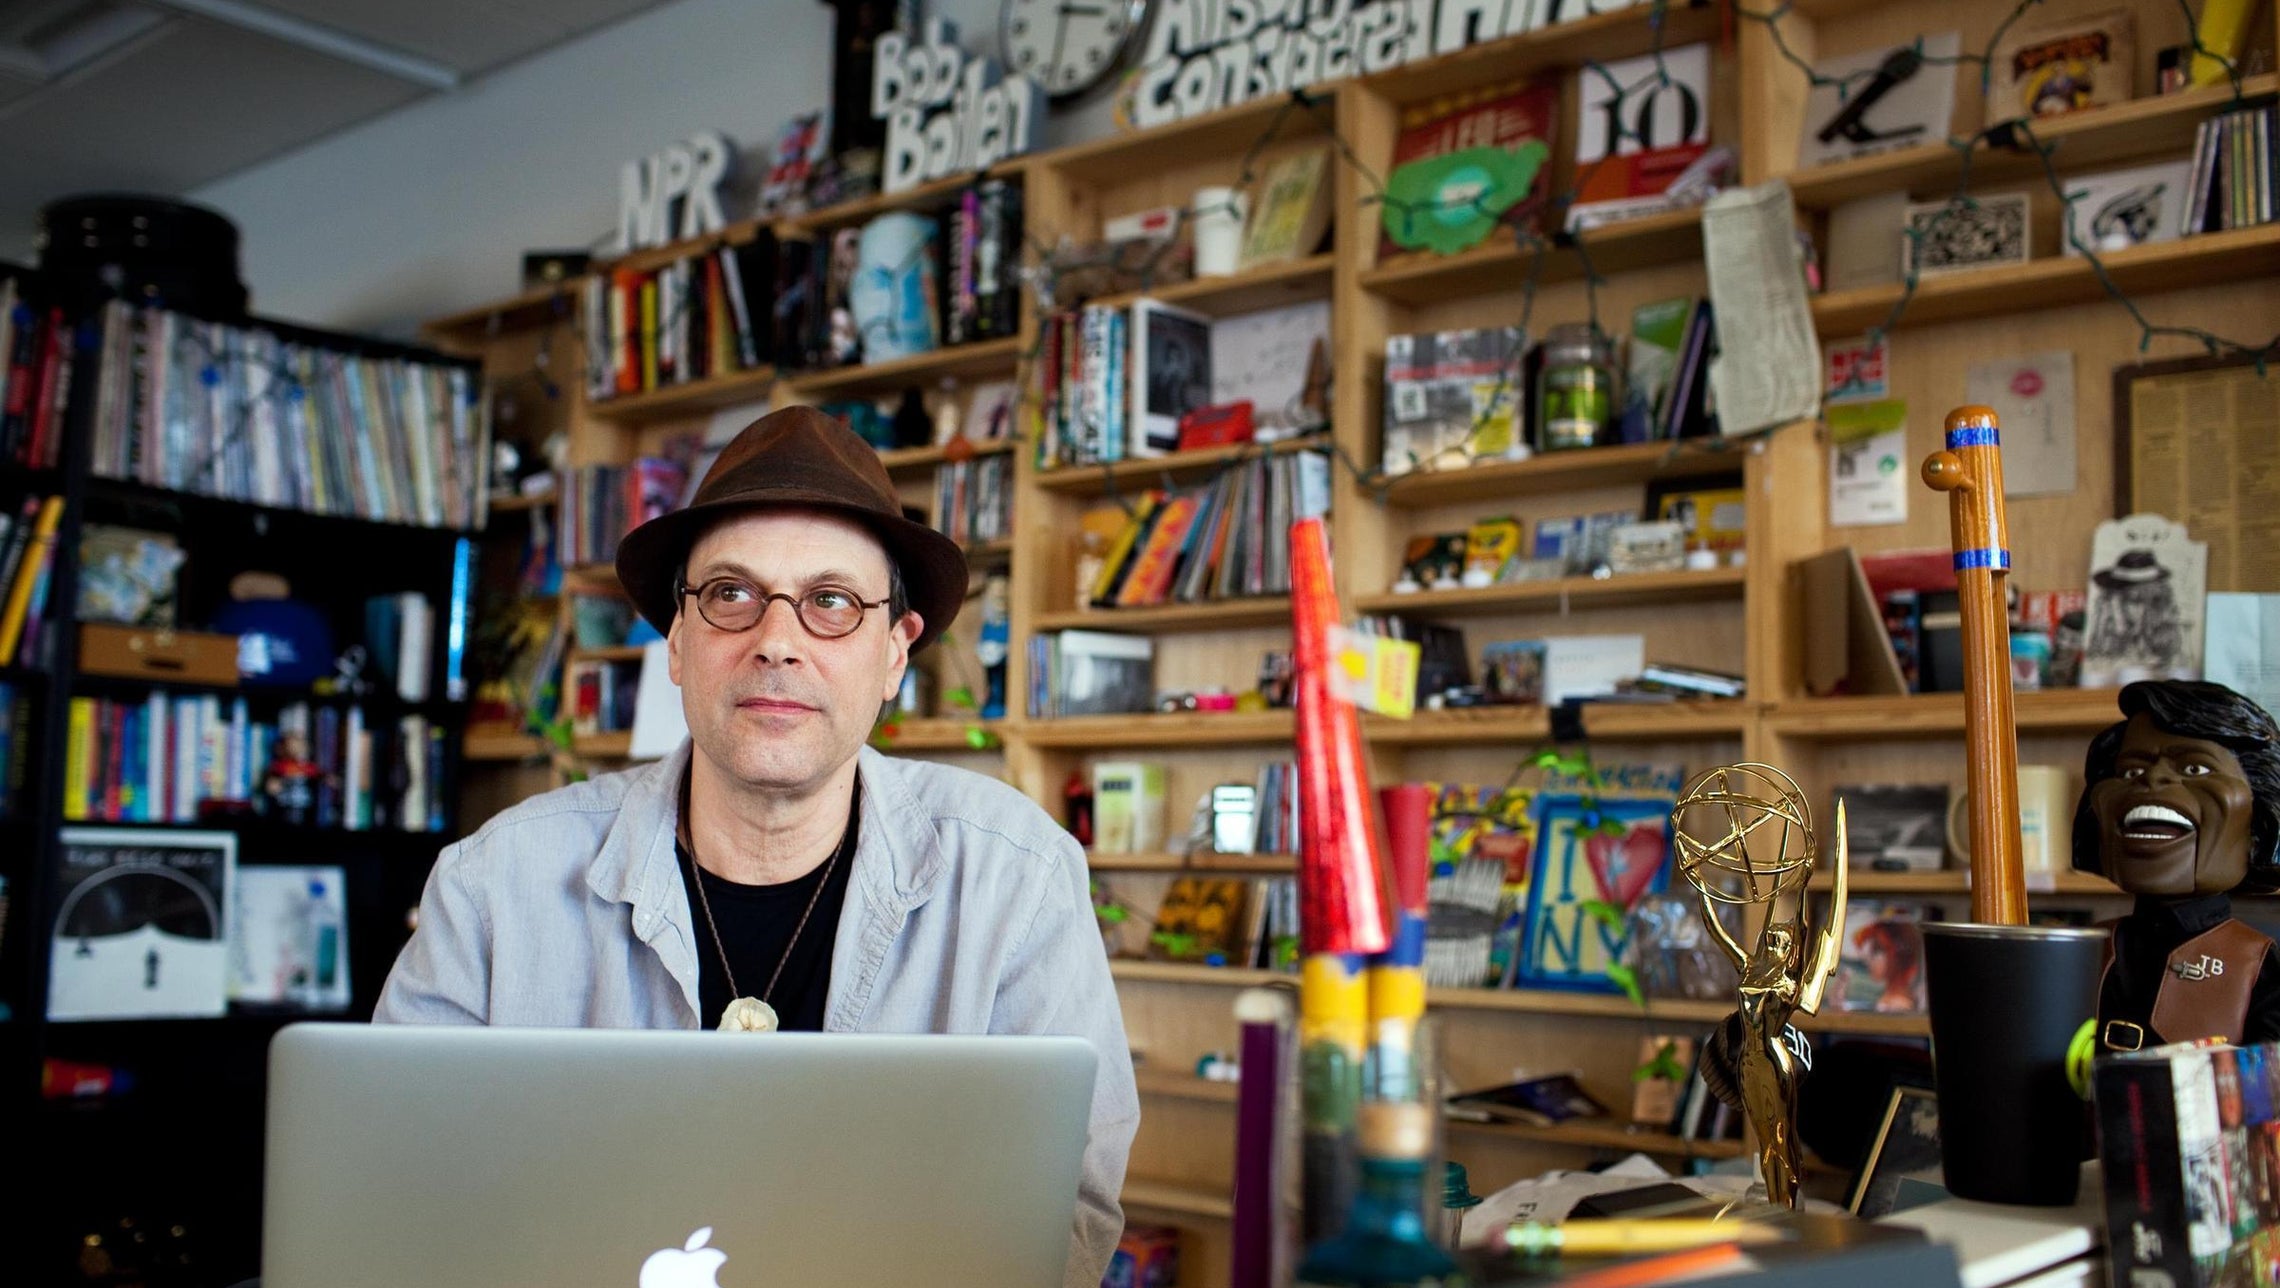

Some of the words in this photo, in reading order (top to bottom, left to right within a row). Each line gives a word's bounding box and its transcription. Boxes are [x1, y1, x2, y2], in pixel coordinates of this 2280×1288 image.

[872, 17, 962, 118] Bob
[1593, 78, 1699, 156] 10
[616, 129, 727, 251] NPR
[1532, 904, 1639, 978] NY
